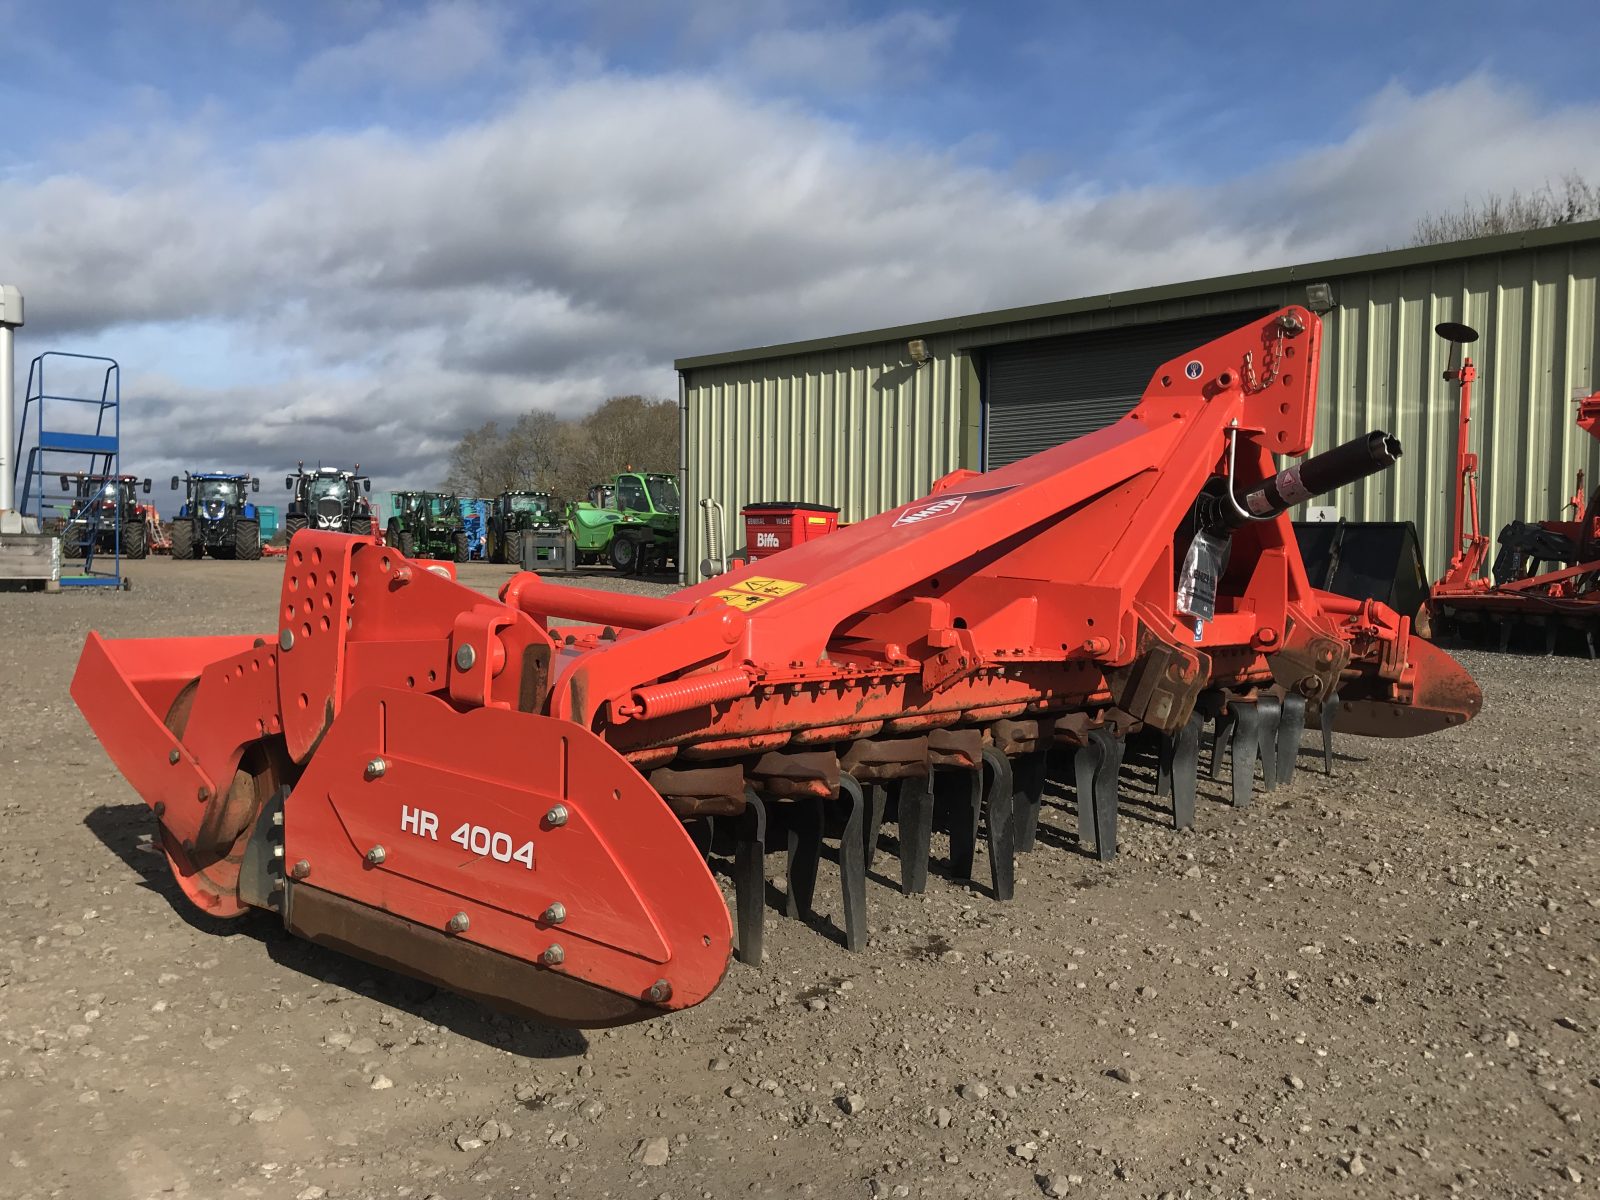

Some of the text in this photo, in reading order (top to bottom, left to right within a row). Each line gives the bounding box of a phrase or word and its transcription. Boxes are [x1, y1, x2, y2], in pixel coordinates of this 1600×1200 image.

[900, 499, 959, 523] KUHN
[757, 532, 780, 547] Biffa
[401, 804, 534, 870] HR 4004
